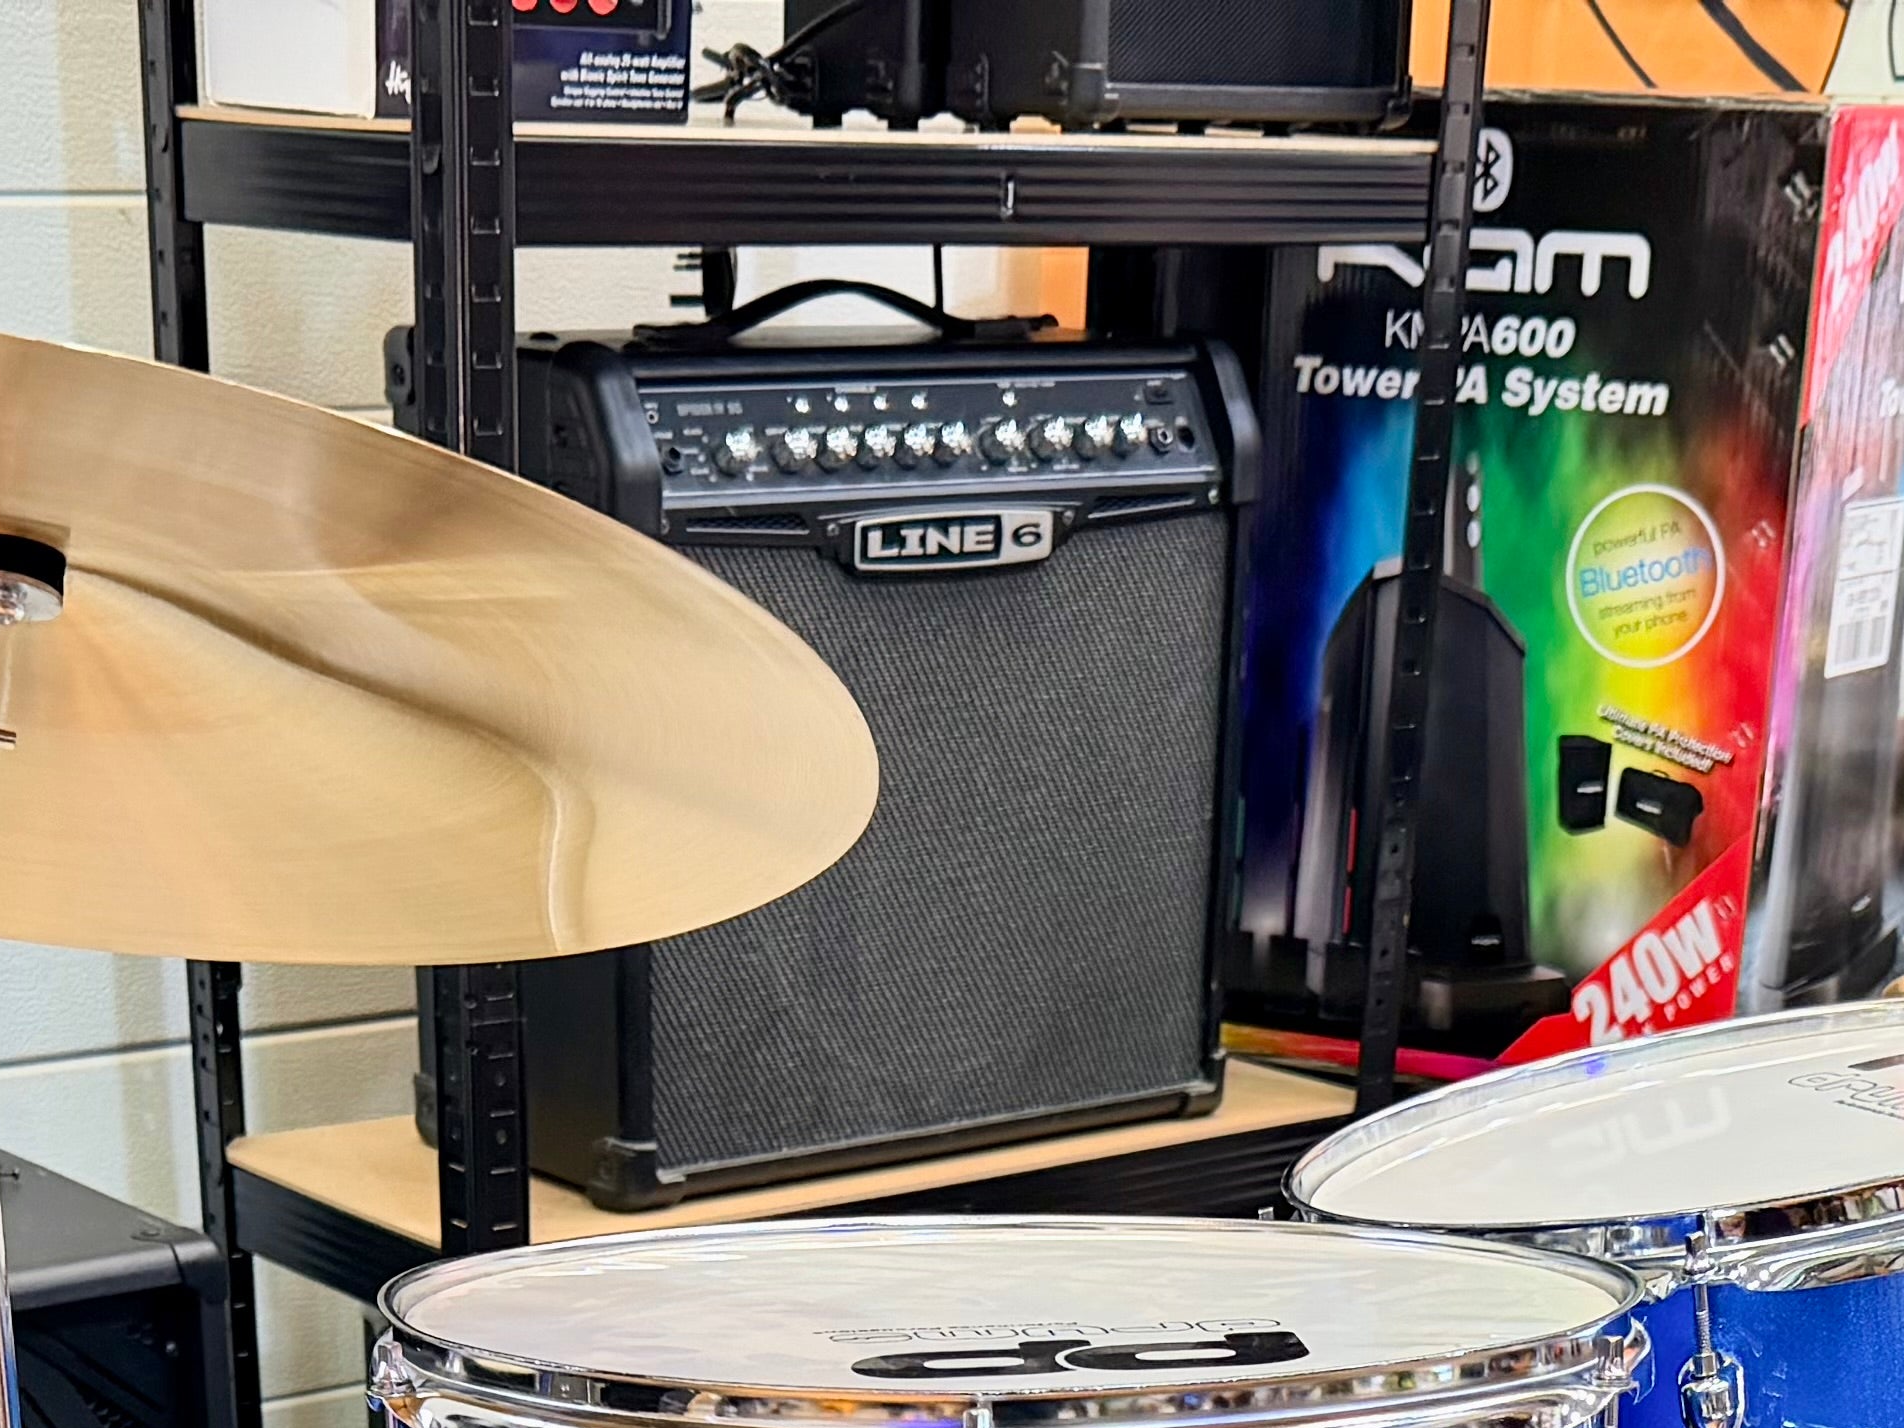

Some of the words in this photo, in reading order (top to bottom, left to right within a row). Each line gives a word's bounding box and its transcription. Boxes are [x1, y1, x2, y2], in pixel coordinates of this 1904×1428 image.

[1295, 355, 1420, 400] Tower
[1454, 363, 1489, 404] A
[1502, 366, 1670, 416] System
[867, 523, 996, 559] LINE
[1011, 522, 1043, 548] 6
[1593, 526, 1657, 557] powerful
[1579, 546, 1714, 599] Bluetooth
